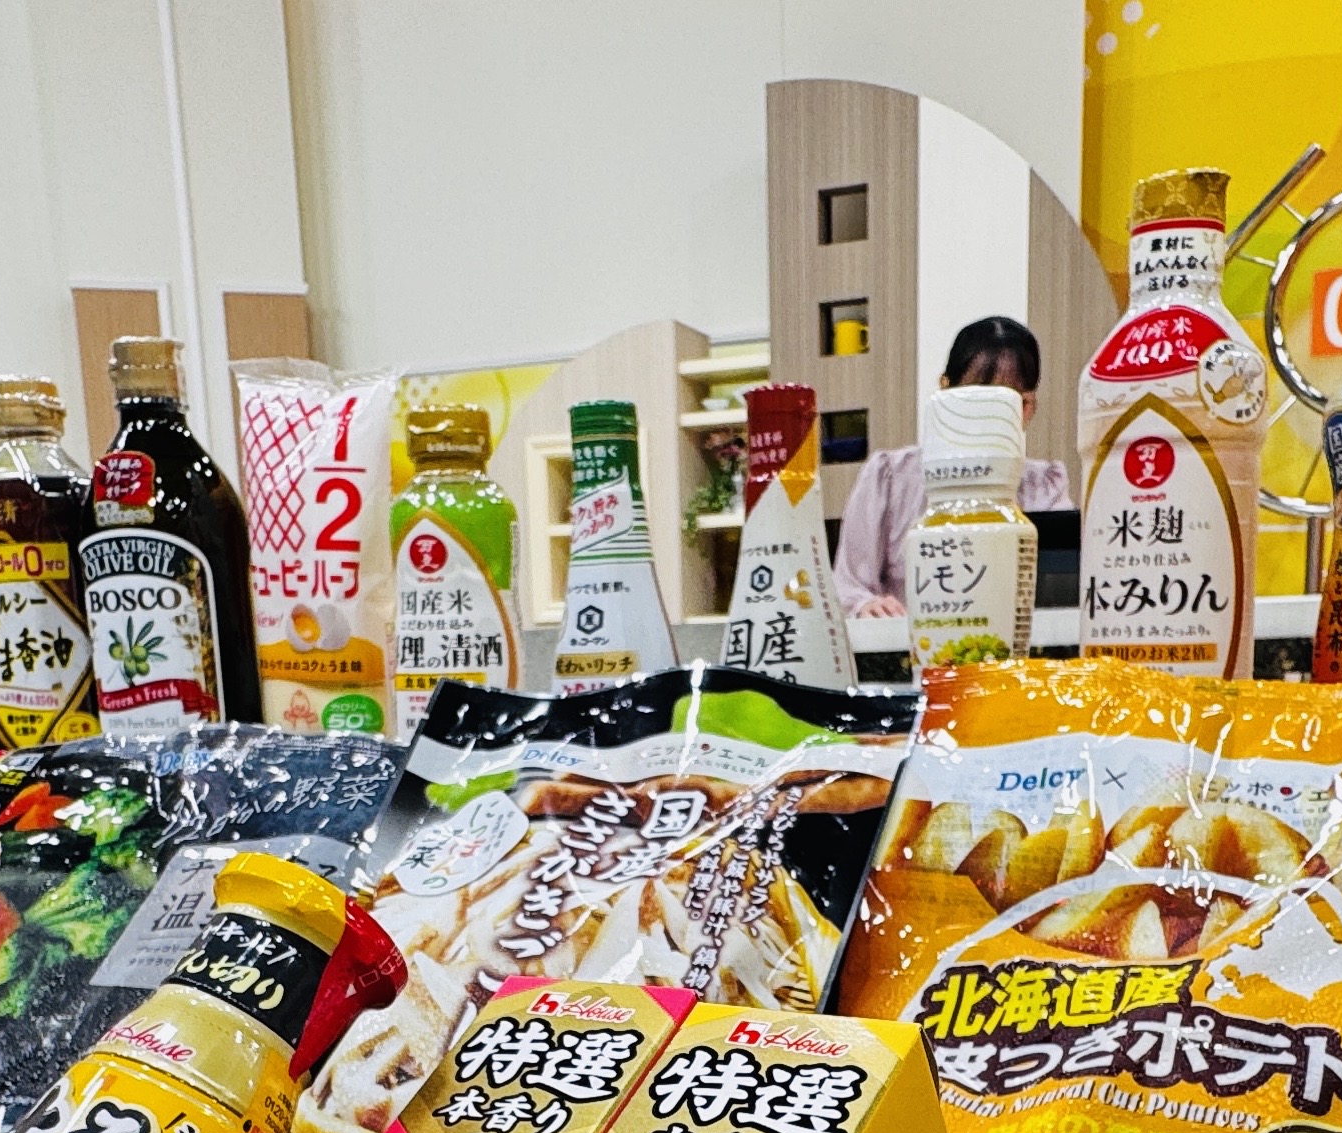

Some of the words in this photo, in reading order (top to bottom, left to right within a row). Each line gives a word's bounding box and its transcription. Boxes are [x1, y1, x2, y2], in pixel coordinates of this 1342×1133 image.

[84, 553, 135, 582] OLIVE
[138, 551, 177, 578] OIL
[121, 539, 177, 560] VIRGIN
[251, 559, 362, 599] ューピーハーフ
[914, 562, 988, 595] レモン
[1085, 573, 1229, 620] 本みりん
[89, 587, 183, 614] BOSCO
[400, 588, 474, 615] 国産米
[397, 632, 504, 668] 理の清酒
[725, 611, 805, 670] 国産
[599, 790, 709, 884] 国産
[925, 961, 1196, 1041] 北海道産
[457, 1019, 643, 1099] 特選
[1012, 1077, 1098, 1114] Natural
[1097, 1076, 1142, 1113] Cut
[1148, 1091, 1263, 1132] Potatoes
